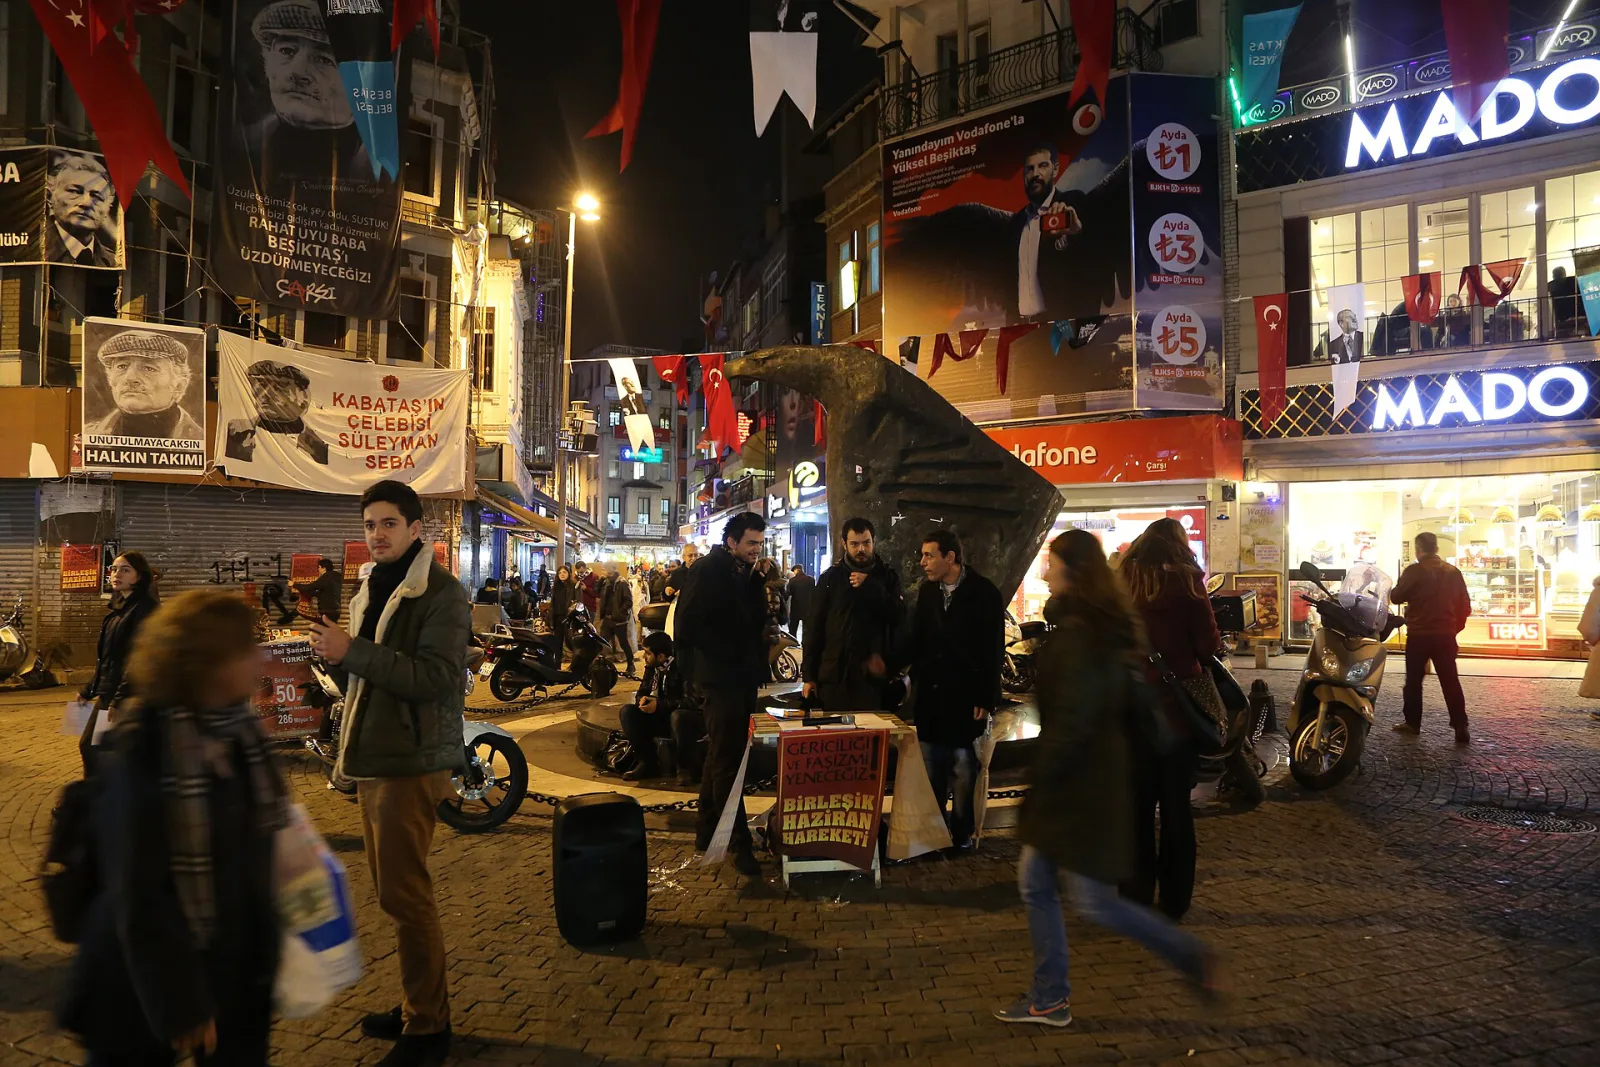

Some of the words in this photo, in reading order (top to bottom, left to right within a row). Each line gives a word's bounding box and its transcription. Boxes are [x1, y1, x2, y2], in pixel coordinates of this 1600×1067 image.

[1362, 78, 1392, 92] MADO
[1306, 91, 1335, 104] MADO
[1254, 104, 1281, 117] MO
[1345, 58, 1600, 168] MADO
[892, 135, 954, 160] Yanındayım
[956, 115, 1024, 140] Vodafone'la
[1160, 130, 1186, 140] Ayda
[892, 156, 928, 174] Yüksel
[930, 144, 976, 164] Beşiktaş
[0, 162, 20, 183] A
[227, 184, 290, 208] Üzüleceğimiz
[293, 203, 308, 212] çok
[310, 206, 326, 217] şey
[351, 214, 388, 229] SUSTUK!
[892, 206, 922, 218] Vodafone
[234, 202, 265, 216] Hiçbiri
[268, 208, 284, 220] bizi
[287, 214, 317, 228] gidişin
[320, 222, 344, 232] kadar
[1164, 220, 1190, 232] Ayda
[249, 216, 296, 236] RAHAT
[298, 226, 328, 242] UYU
[332, 233, 366, 251] BABA
[240, 246, 371, 284] ÜZDÜRMEYECEĞİZ!
[816, 284, 826, 339] TEKNİK
[1166, 312, 1192, 324] Ayda
[332, 392, 444, 416] KABATAŞ'IN
[1372, 366, 1588, 429] MADO
[348, 414, 432, 432] ÇELEBİSİ
[89, 436, 200, 448] UNUTULMAYACAKSIN
[338, 431, 438, 450] SÜLEYMAN
[86, 450, 146, 464] HALKIN
[150, 452, 202, 466] TAKIMI
[366, 455, 415, 469] SEBA
[1146, 462, 1166, 470] Çarşı
[62, 569, 97, 577] BİRLEŞİK
[63, 576, 96, 584] HAZİRAN
[1490, 624, 1538, 638] TERAS
[276, 684, 296, 703] 50
[278, 714, 293, 724] 286
[788, 736, 870, 756] GERİCİLİĞİ
[787, 760, 800, 770] VE
[806, 753, 868, 772] FAŞİZMİ
[783, 792, 875, 812] BİRLEŞİK
[783, 809, 872, 830] HAZİRAN
[782, 828, 869, 848] HAREKETİ
